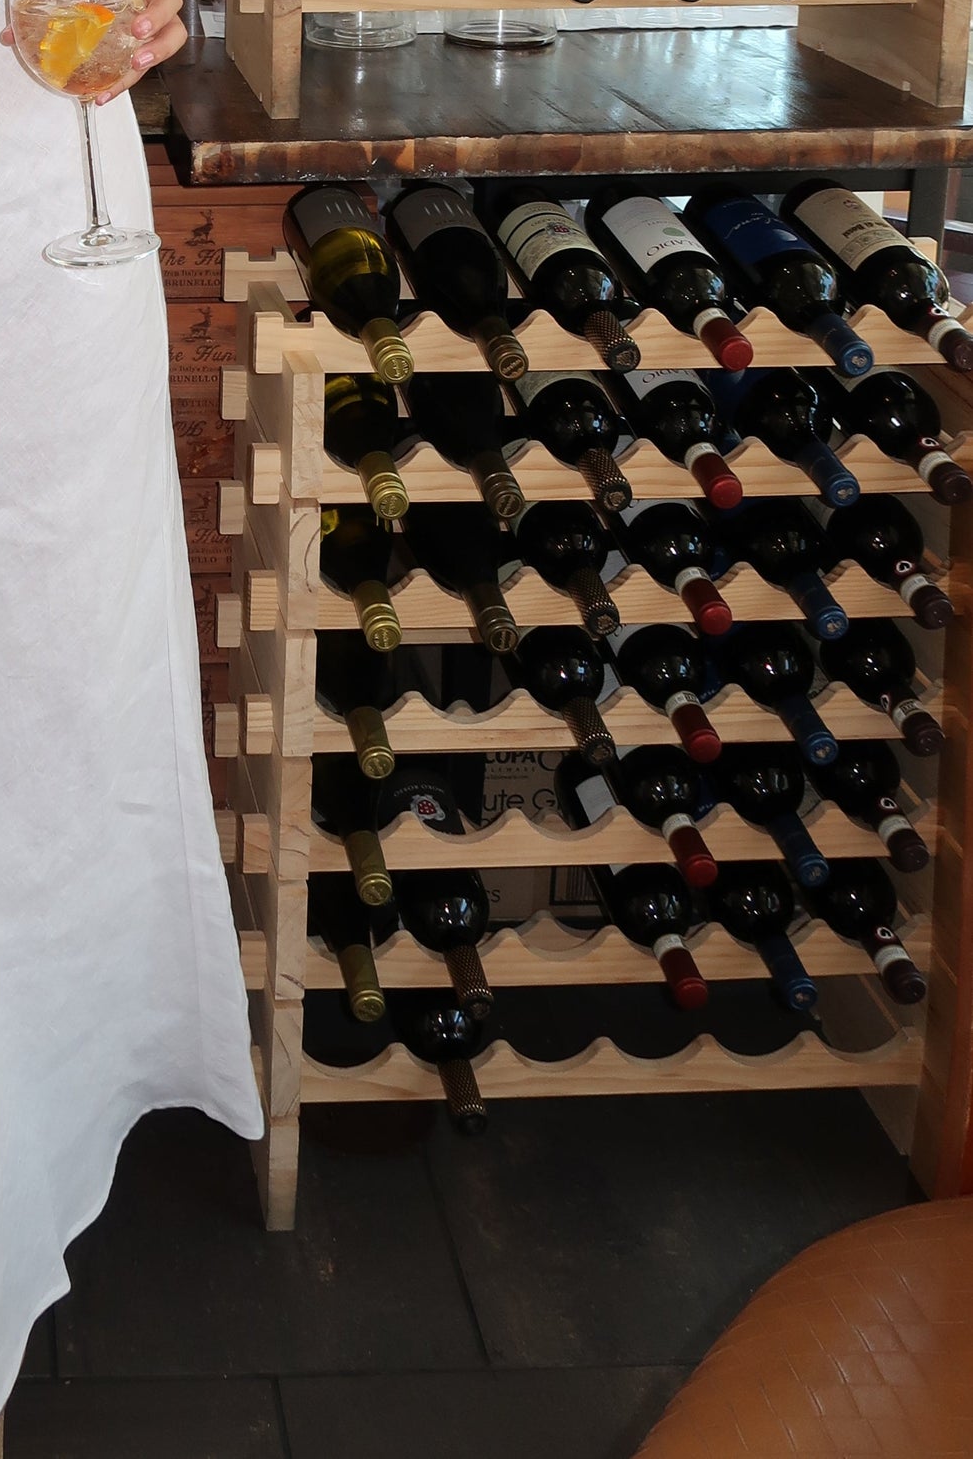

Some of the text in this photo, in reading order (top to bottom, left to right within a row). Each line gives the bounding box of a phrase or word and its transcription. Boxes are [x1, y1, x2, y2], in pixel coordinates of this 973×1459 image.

[193, 344, 235, 362] Hun
[483, 788, 556, 812] ute G
